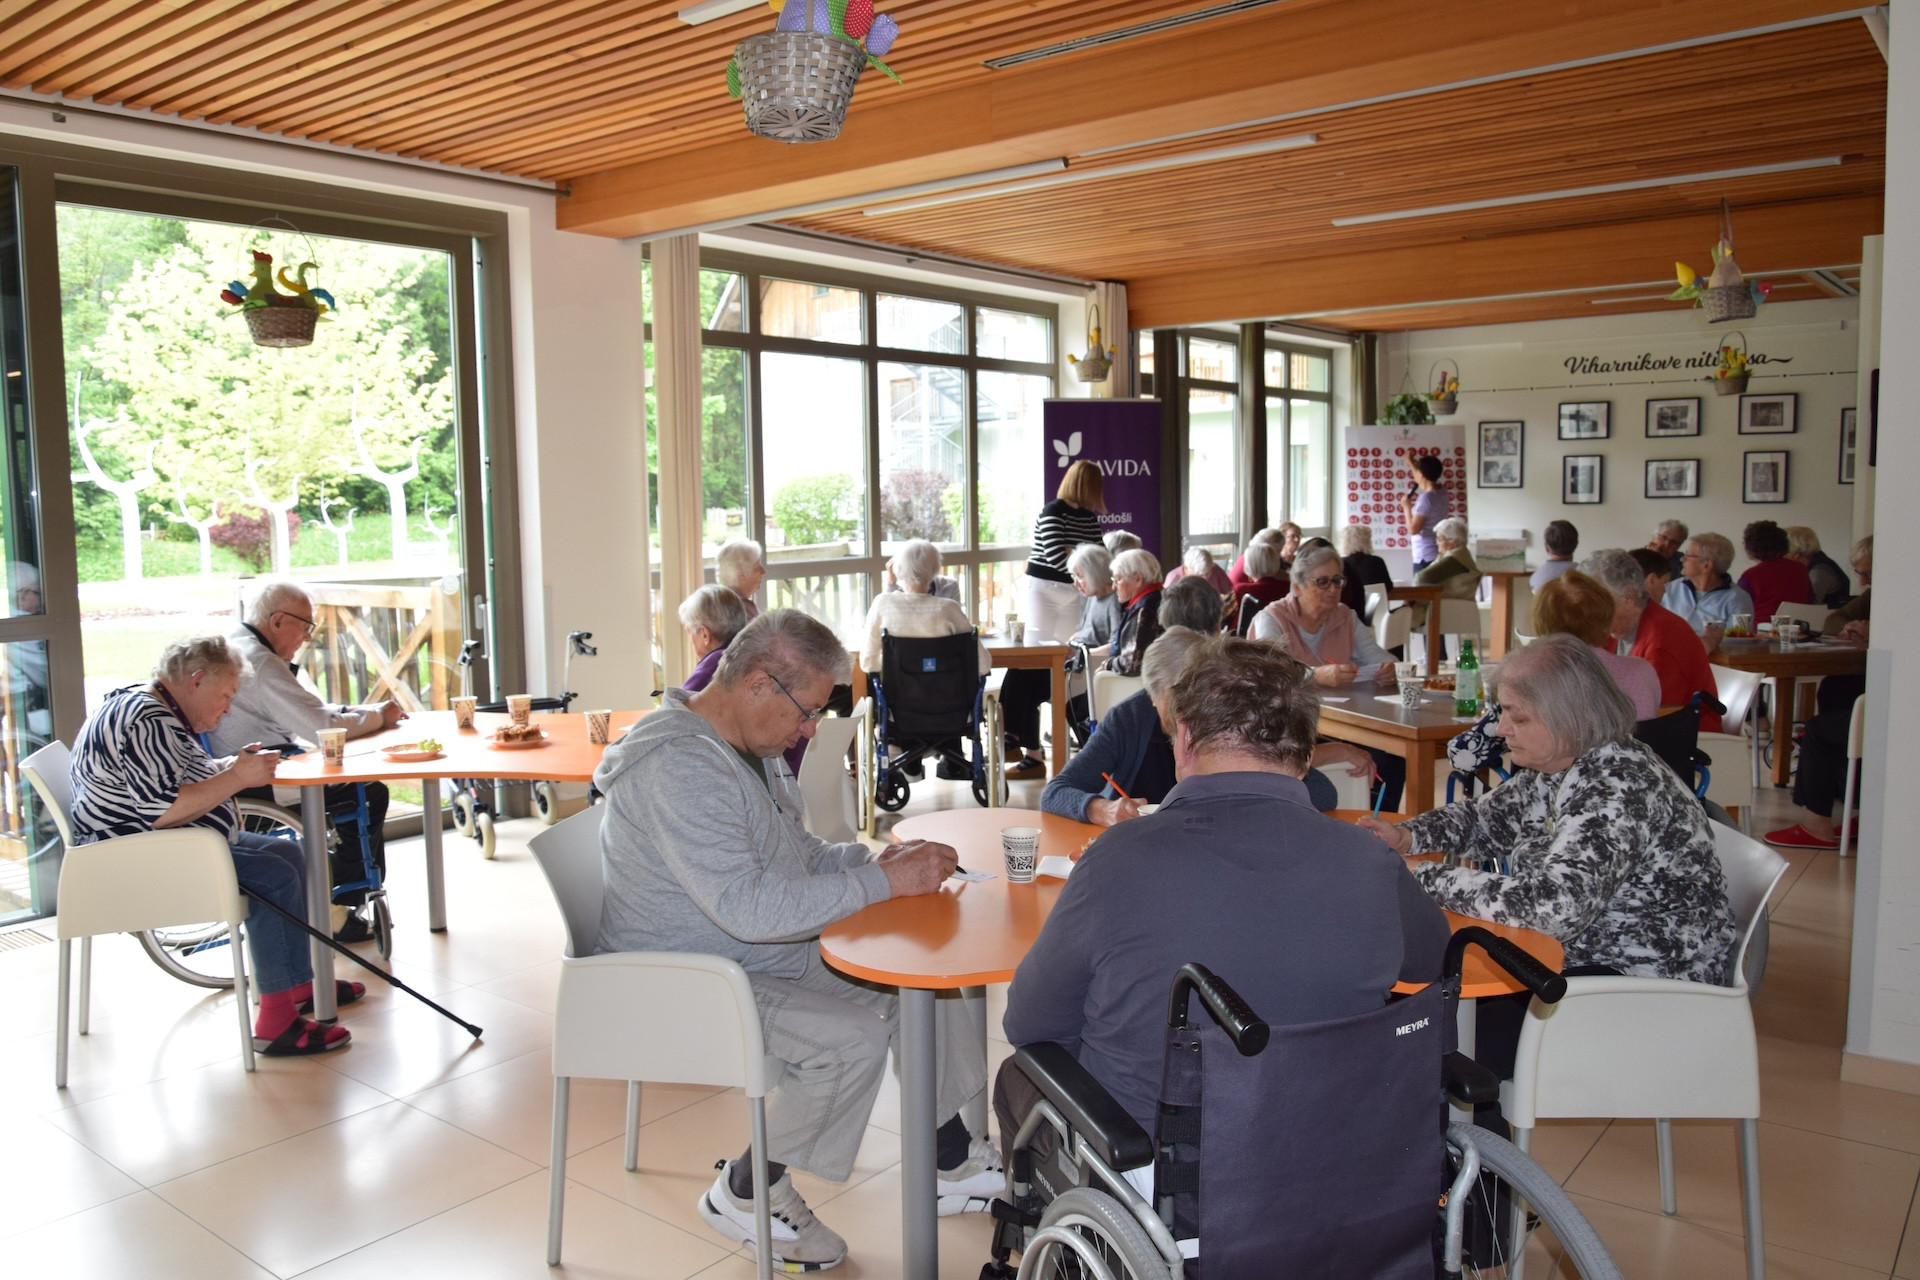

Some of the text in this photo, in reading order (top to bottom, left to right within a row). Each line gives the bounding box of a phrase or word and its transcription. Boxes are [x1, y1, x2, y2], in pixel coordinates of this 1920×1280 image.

[1563, 352, 1681, 375] Viharnikove
[1684, 350, 1721, 369] niti
[1088, 459, 1151, 477] AVIDA
[1096, 512, 1132, 524] rodošli
[1395, 1016, 1430, 1037] MEYRA
